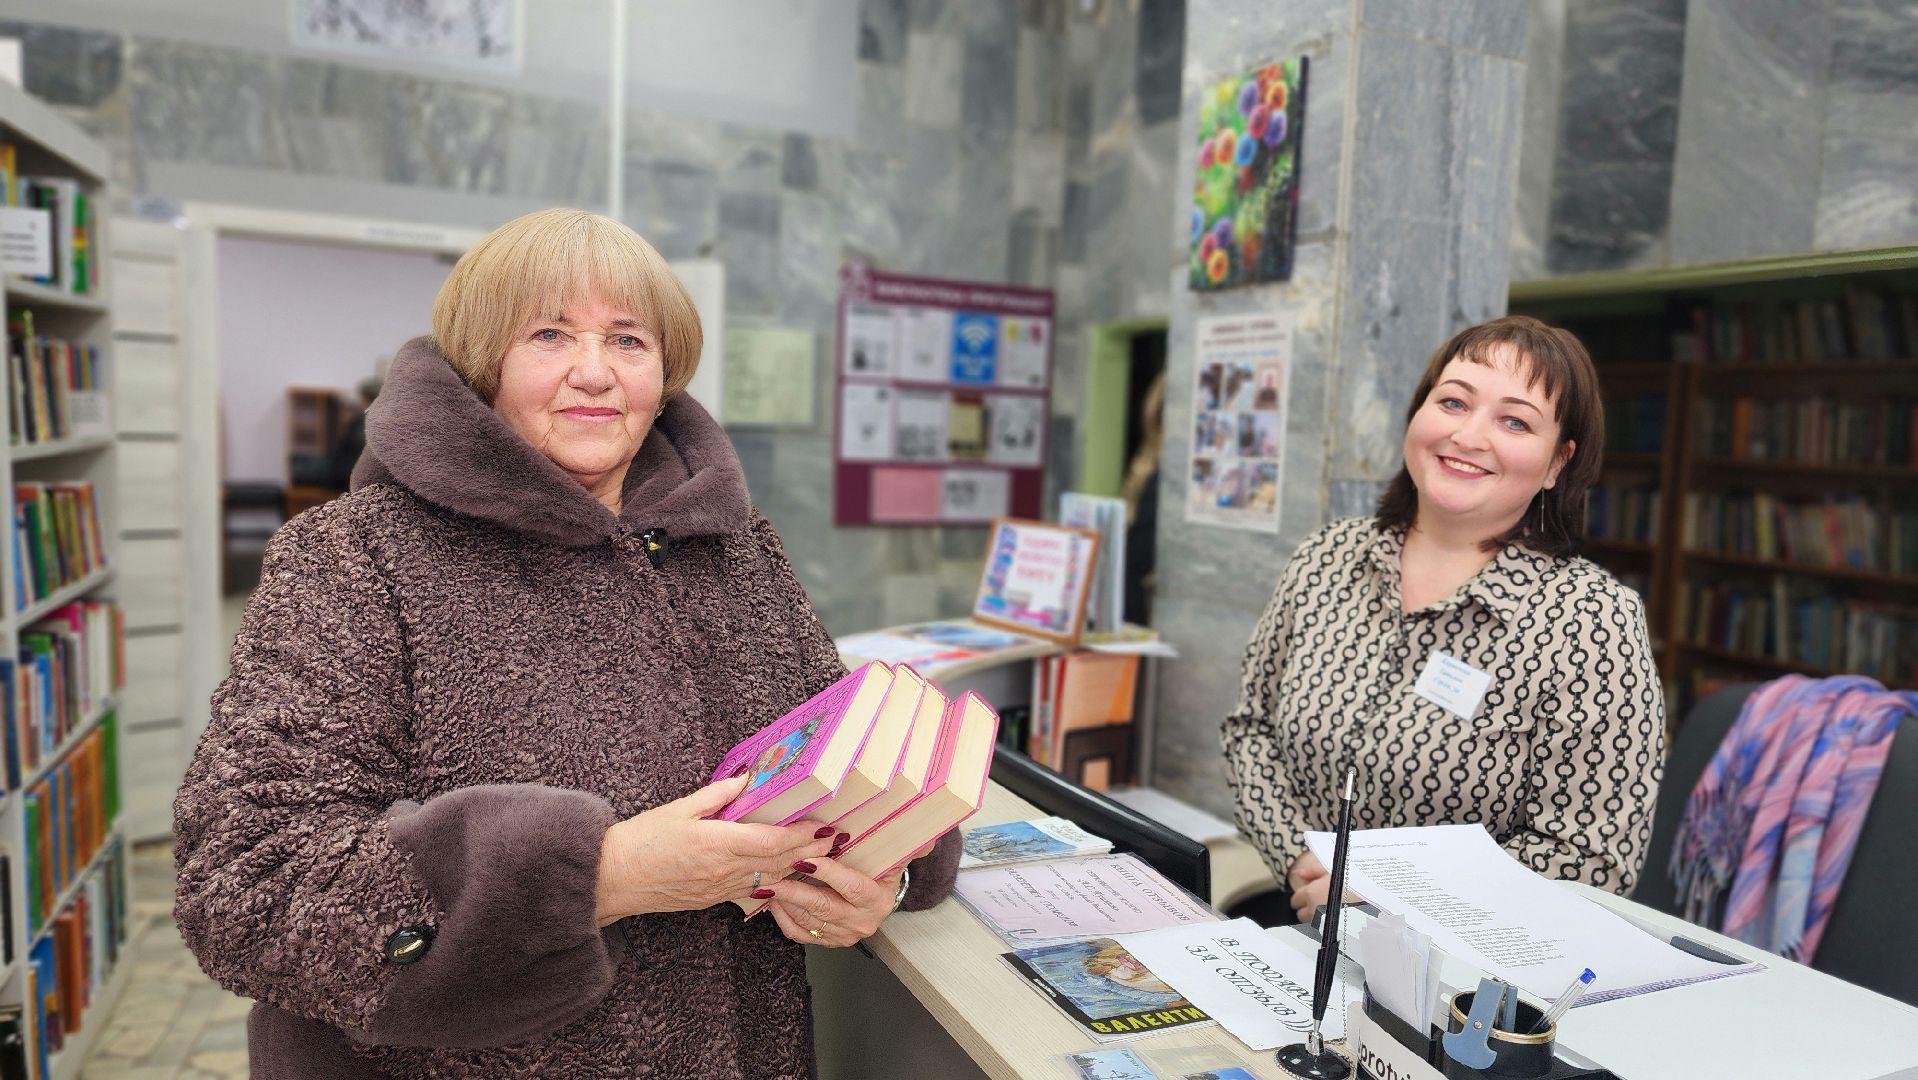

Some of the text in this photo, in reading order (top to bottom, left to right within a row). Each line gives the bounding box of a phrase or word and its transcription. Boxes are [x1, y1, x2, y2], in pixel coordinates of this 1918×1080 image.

[1110, 864, 1143, 887] КНИГА
[1142, 888, 1191, 921] ОТЗЫВОВ
[1184, 945, 1221, 962] ЗА
[1215, 966, 1297, 1016] ОТЗЫВ
[1217, 937, 1337, 1010] В ПОДАРО
[1090, 1007, 1207, 1033] ВАЛЕНТИ
